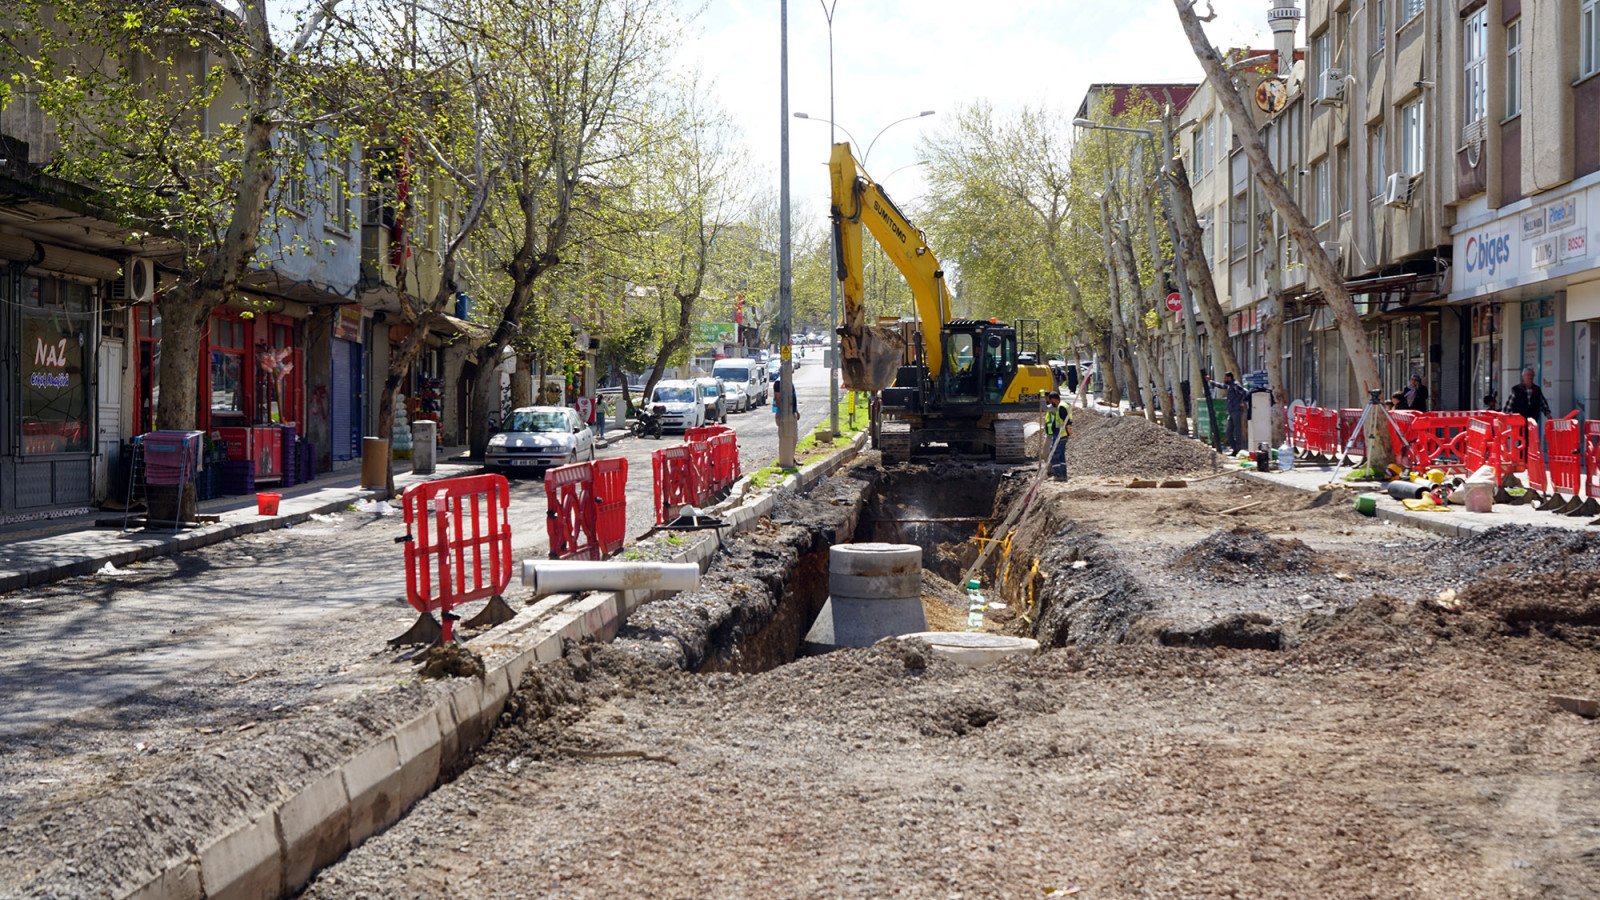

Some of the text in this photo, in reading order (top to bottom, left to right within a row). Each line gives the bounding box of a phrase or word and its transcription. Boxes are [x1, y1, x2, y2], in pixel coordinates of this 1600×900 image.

[873, 200, 906, 243] SUMITOMO
[1567, 235, 1585, 251] BOSCH
[34, 337, 67, 367] NAZ
